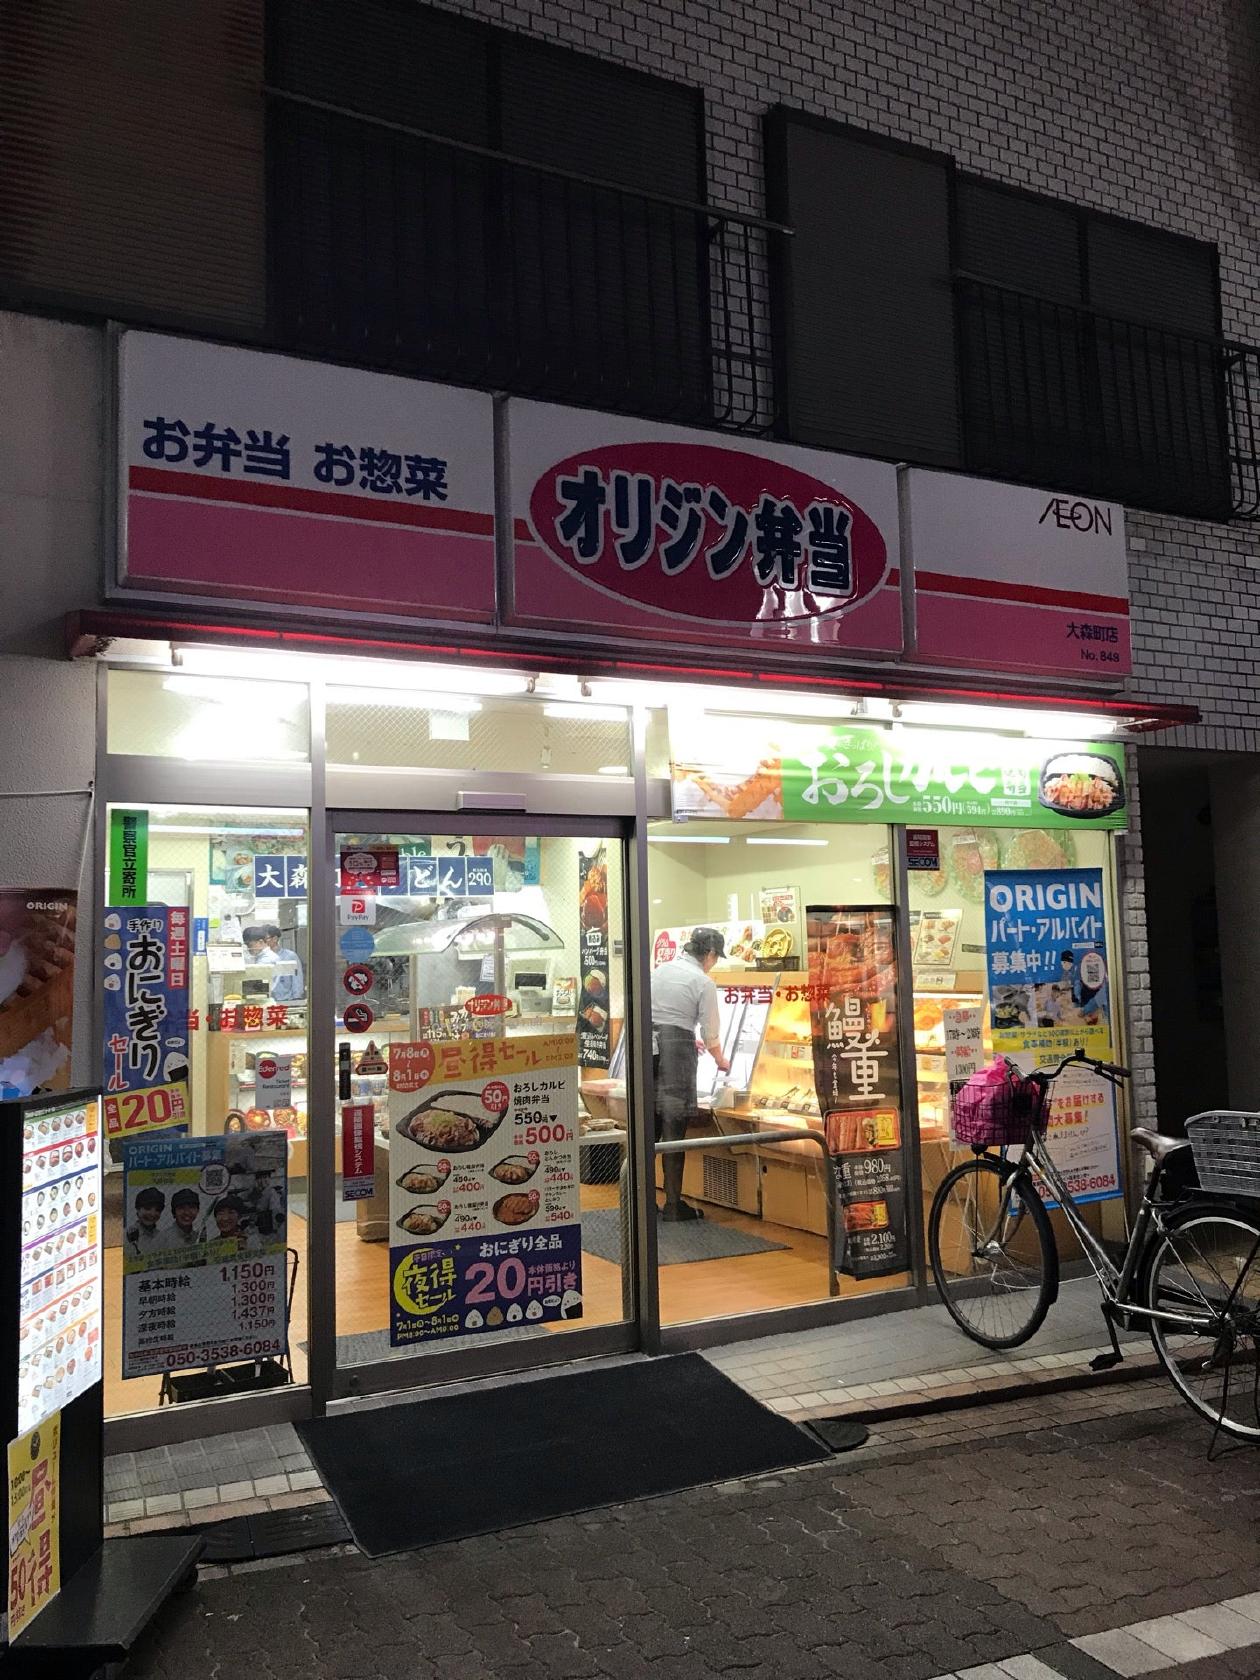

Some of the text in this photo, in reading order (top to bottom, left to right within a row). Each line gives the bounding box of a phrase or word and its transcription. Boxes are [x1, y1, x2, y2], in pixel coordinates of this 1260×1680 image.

[143, 416, 448, 501] お弁当 お惣菜
[555, 463, 853, 597] オリジン弁当
[1066, 621, 1119, 643] 大森町店
[121, 815, 138, 899] 警察官立寄所
[908, 857, 939, 867] SECOM
[468, 872, 492, 887] 290
[26, 902, 68, 911] ORIGIN
[988, 882, 1101, 913] ORIGIN
[126, 917, 163, 933] 手作り
[347, 914, 370, 922] PayPay
[990, 915, 1103, 943] パート・アルバイト
[170, 911, 186, 987] 毎週土曜日
[991, 950, 1057, 975] 募集中!!
[723, 983, 831, 1004] お弁当・お惣菜
[125, 934, 165, 1080] おにぎり
[438, 1041, 543, 1079] 昼得セール
[824, 995, 889, 1101] 鰻重
[107, 1033, 129, 1092] セール
[513, 1081, 567, 1093] おろしカルビ
[513, 1095, 550, 1107] 焼肉弁当
[107, 1103, 120, 1130] 全品
[514, 1111, 543, 1125] 550
[128, 1143, 173, 1155] ORIGIN
[345, 1187, 373, 1199] SECOM
[479, 1233, 563, 1258] おにぎり全品
[402, 1257, 457, 1295] 夜得
[527, 1259, 577, 1275] 本体価格より
[137, 1275, 191, 1292] 基本時給
[464, 1257, 527, 1305] 20
[527, 1272, 578, 1297] 円引き
[415, 1293, 456, 1309] セール
